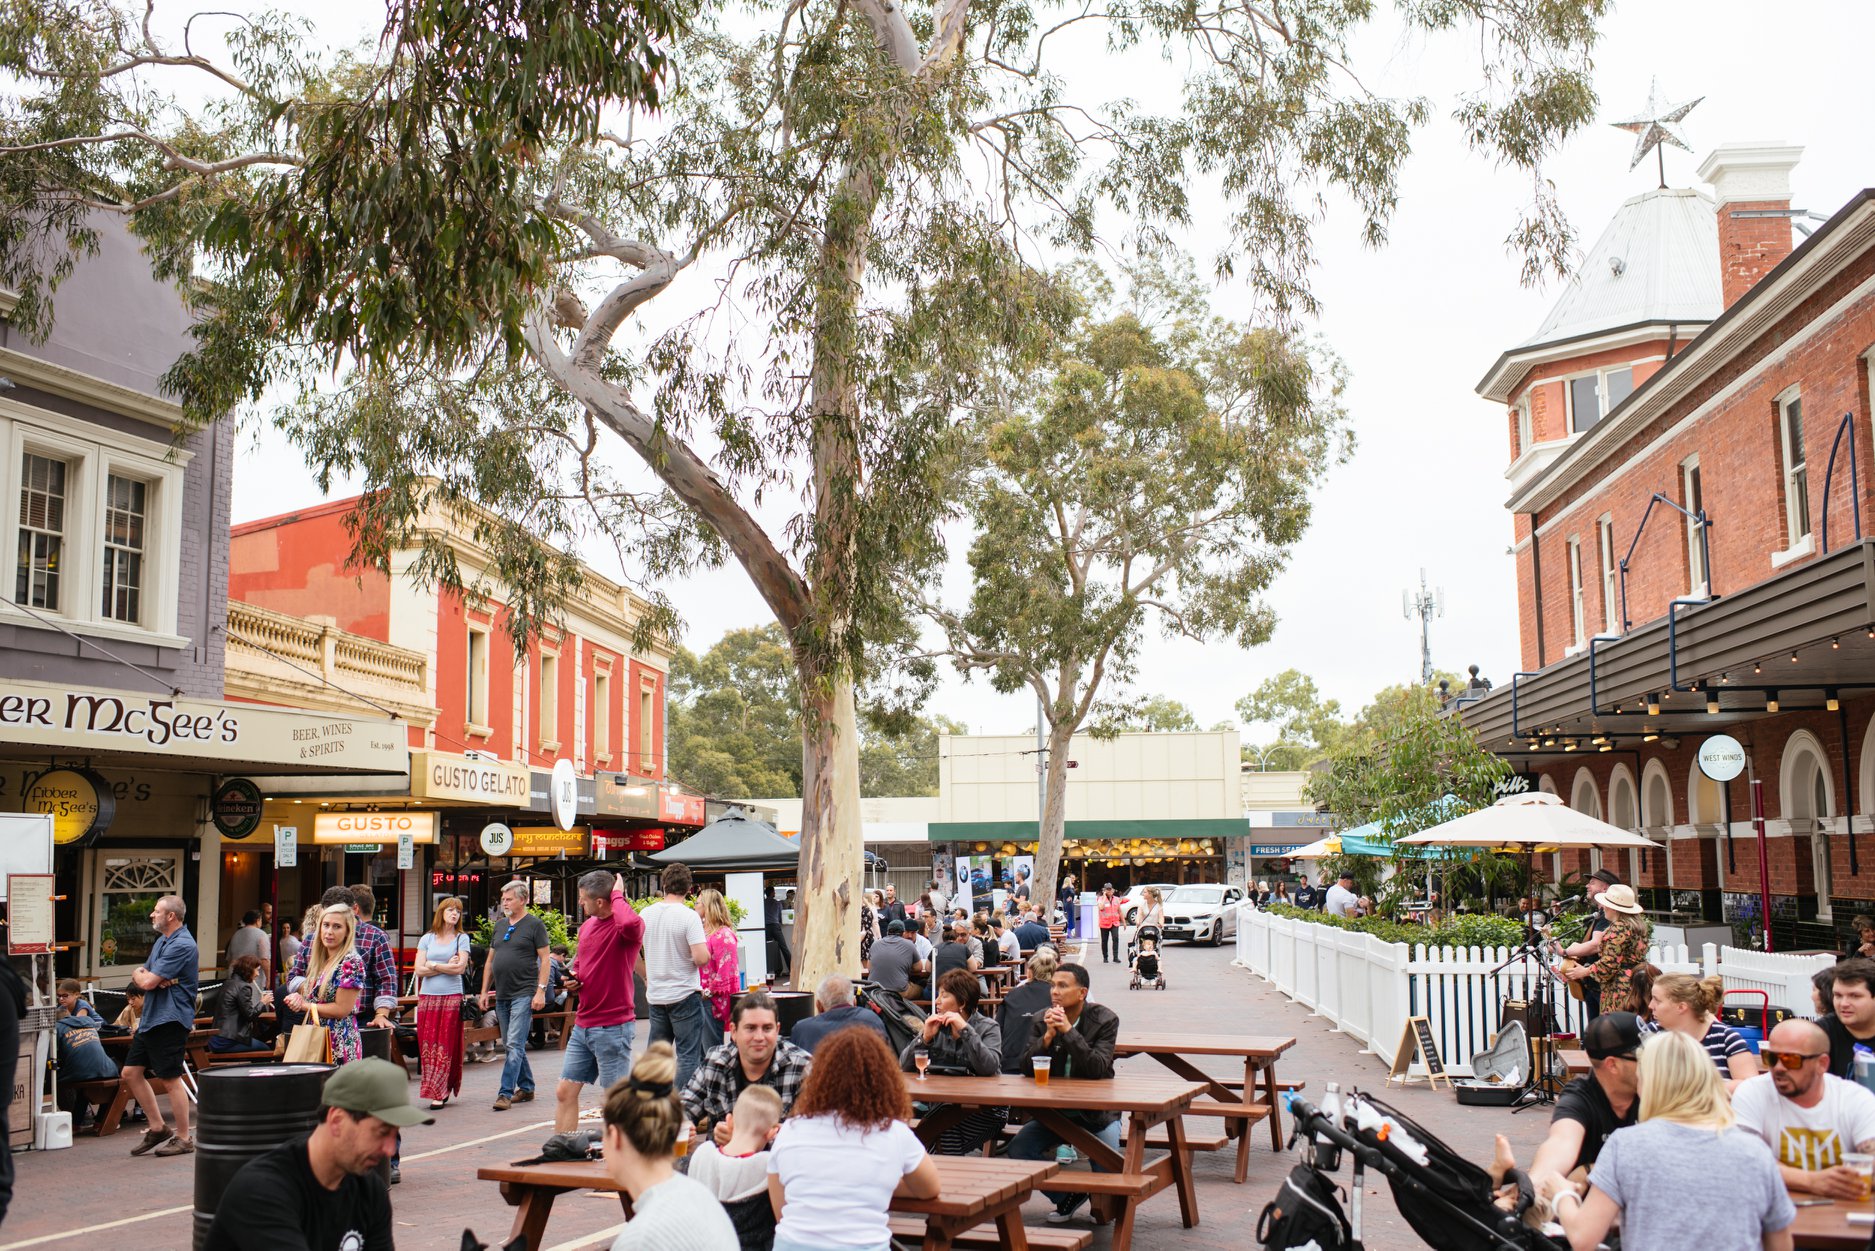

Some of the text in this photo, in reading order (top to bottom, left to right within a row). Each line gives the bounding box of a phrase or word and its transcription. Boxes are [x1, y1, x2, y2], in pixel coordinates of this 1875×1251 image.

[292, 723, 353, 742] BEER, WINES
[300, 740, 345, 758] & SPIRITS
[370, 740, 395, 751] Est. 1998
[1703, 753, 1742, 762] WEST WINDS
[433, 764, 526, 796] GUSTO GELATO
[337, 817, 413, 831] GUSTO
[284, 831, 292, 841] P
[402, 837, 409, 846] P
[489, 832, 504, 844] JUS
[1255, 846, 1281, 854] FRESH
